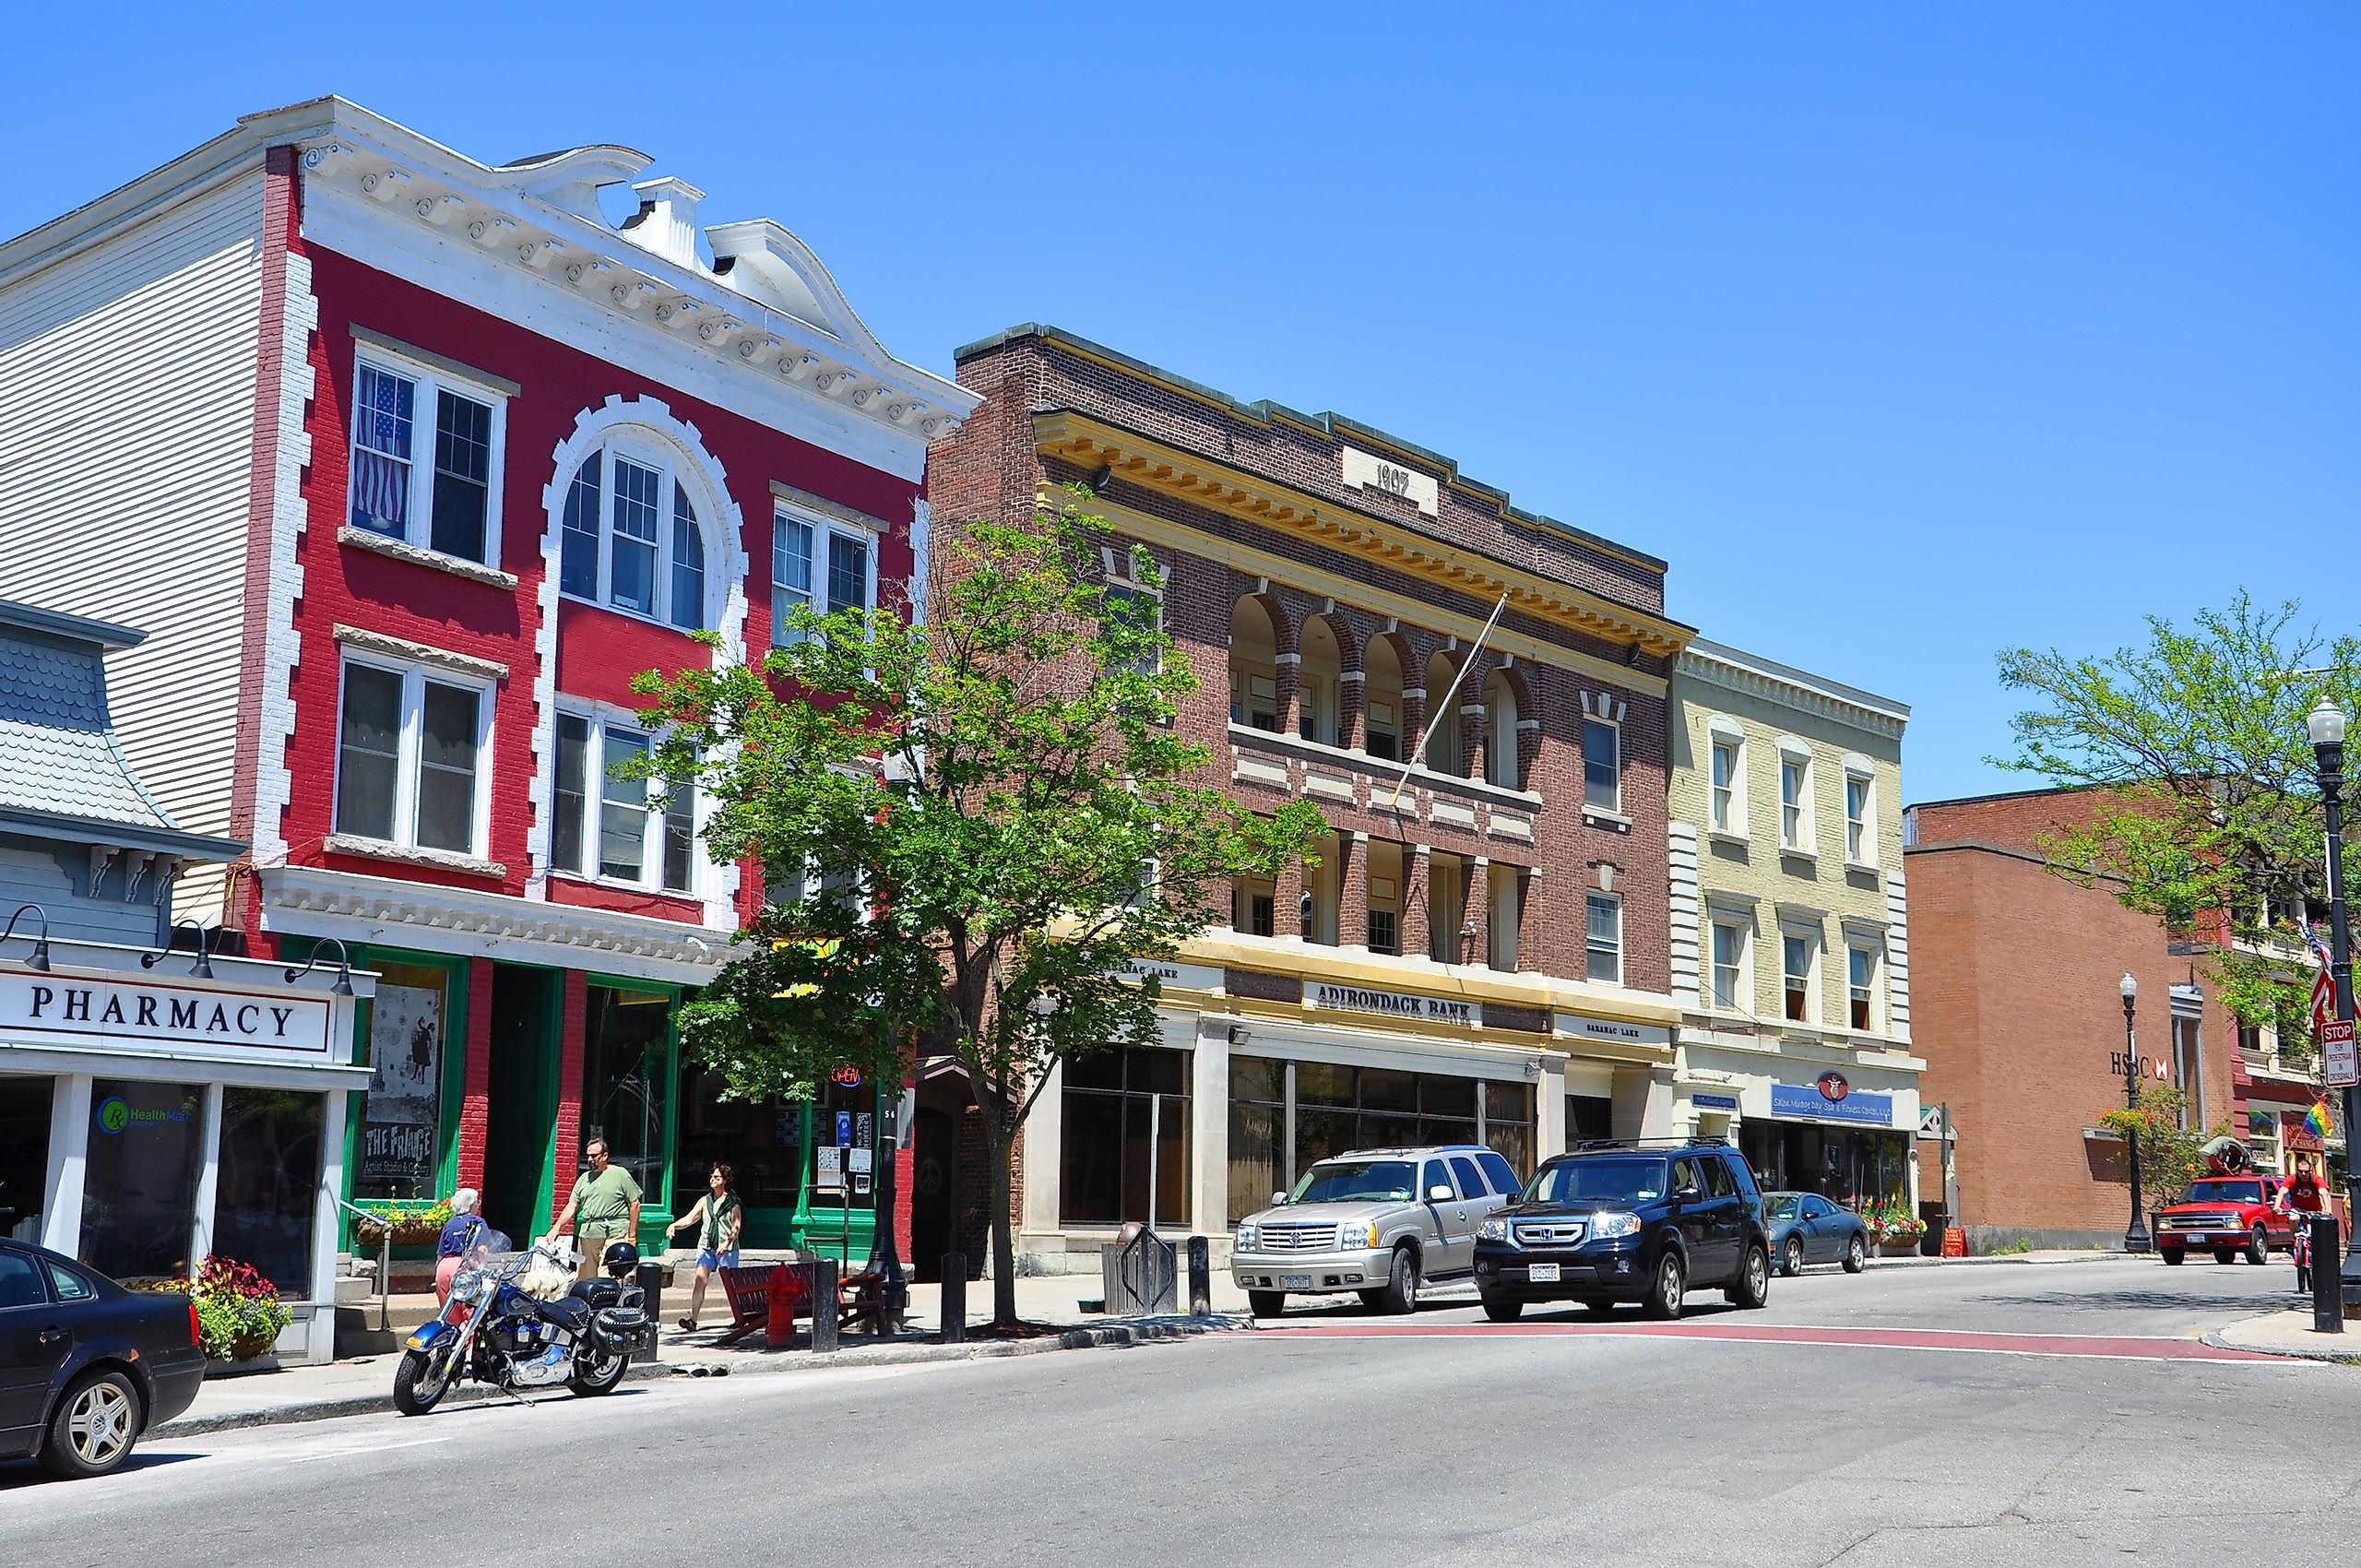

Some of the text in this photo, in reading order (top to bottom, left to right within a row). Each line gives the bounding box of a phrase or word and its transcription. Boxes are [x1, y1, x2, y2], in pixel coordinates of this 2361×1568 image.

[1377, 463, 1409, 493] 1907
[1152, 967, 1178, 979] LAKE
[29, 985, 293, 1037] PHARMACY
[1319, 986, 1470, 1020] ADIRONDACK BANK
[1621, 1028, 1639, 1038] LAKE
[2325, 1026, 2351, 1039] STOP
[366, 1128, 387, 1157] THE
